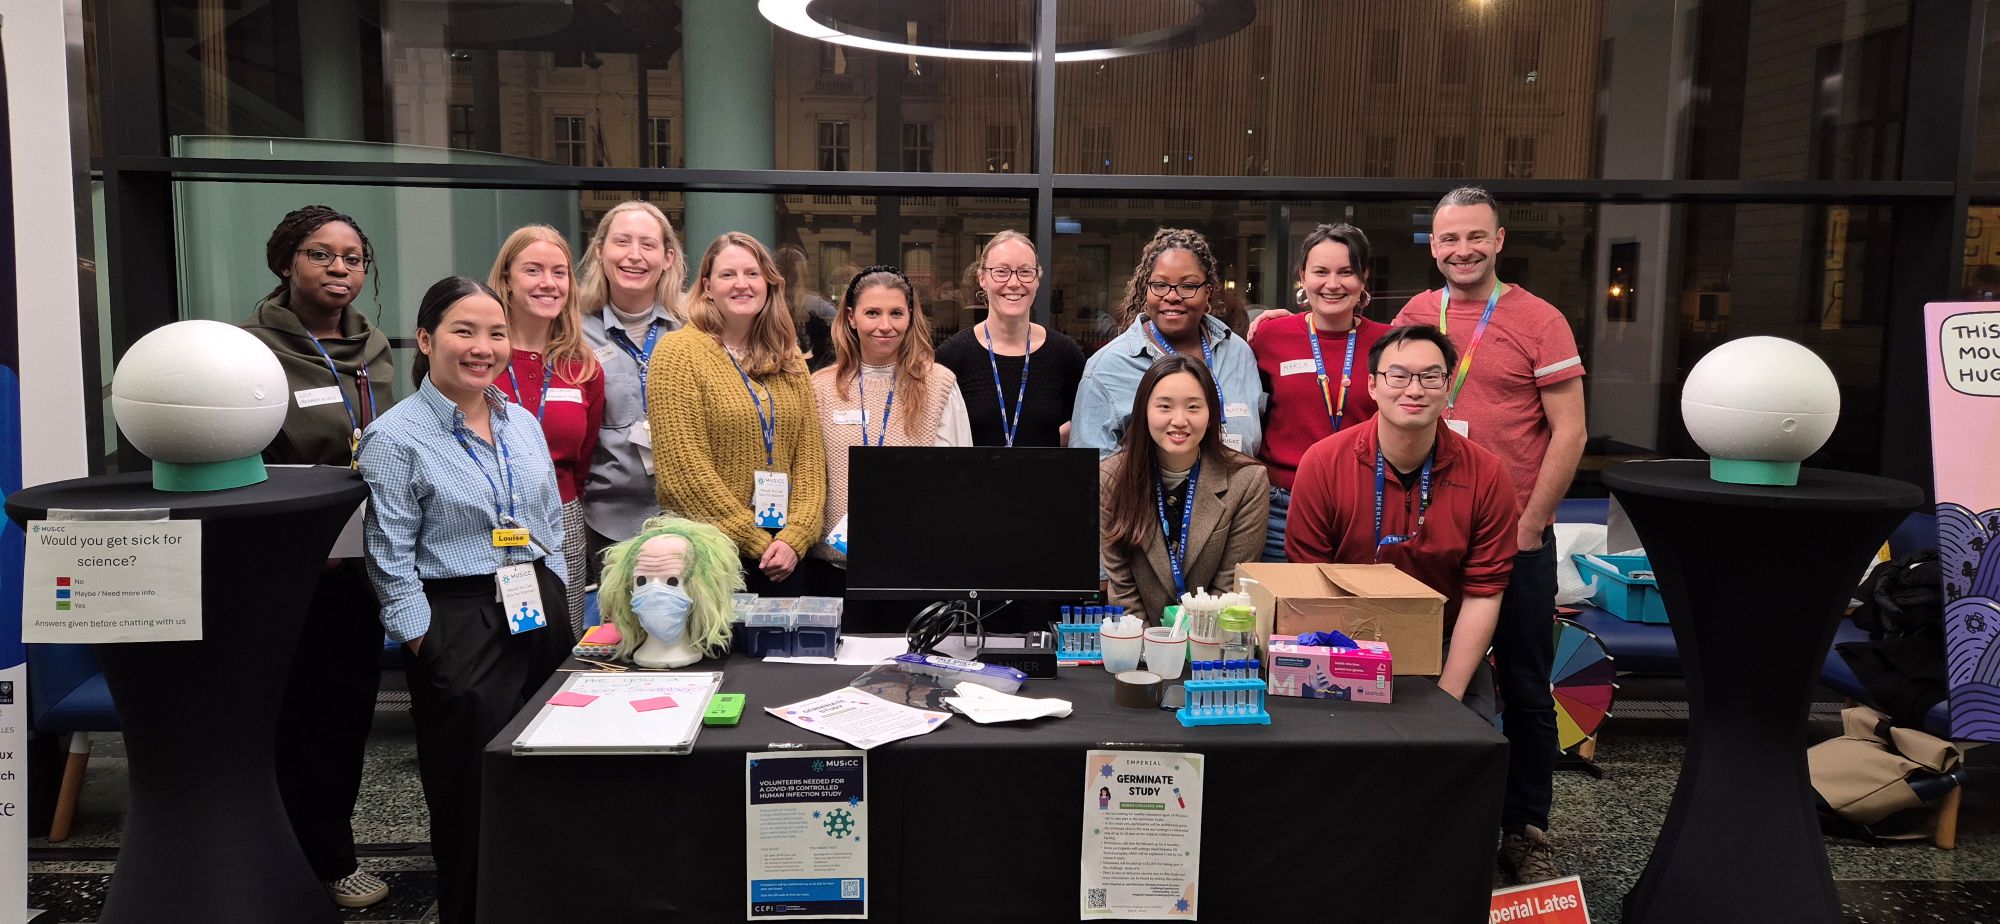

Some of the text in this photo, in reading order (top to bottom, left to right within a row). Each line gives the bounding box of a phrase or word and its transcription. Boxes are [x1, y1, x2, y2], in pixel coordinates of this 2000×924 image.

[1311, 339, 1323, 370] IMPERIAL
[1344, 338, 1355, 370] IMPERIAL
[1184, 479, 1196, 518] IMPERIAL
[1375, 491, 1384, 531] IMPERIAL
[40, 534, 182, 548] Would you get sick for
[77, 555, 137, 567] science?
[75, 590, 97, 598] Maybe
[34, 619, 67, 628] Answers
[68, 620, 89, 629] given
[90, 619, 117, 628] before
[119, 618, 155, 629] chatting
[155, 618, 175, 626] with
[759, 779, 802, 787] VOLUNTEERS
[1117, 774, 1174, 785] GERMINATE
[1129, 786, 1161, 796] STUDY
[1534, 893, 1578, 915] Lates
